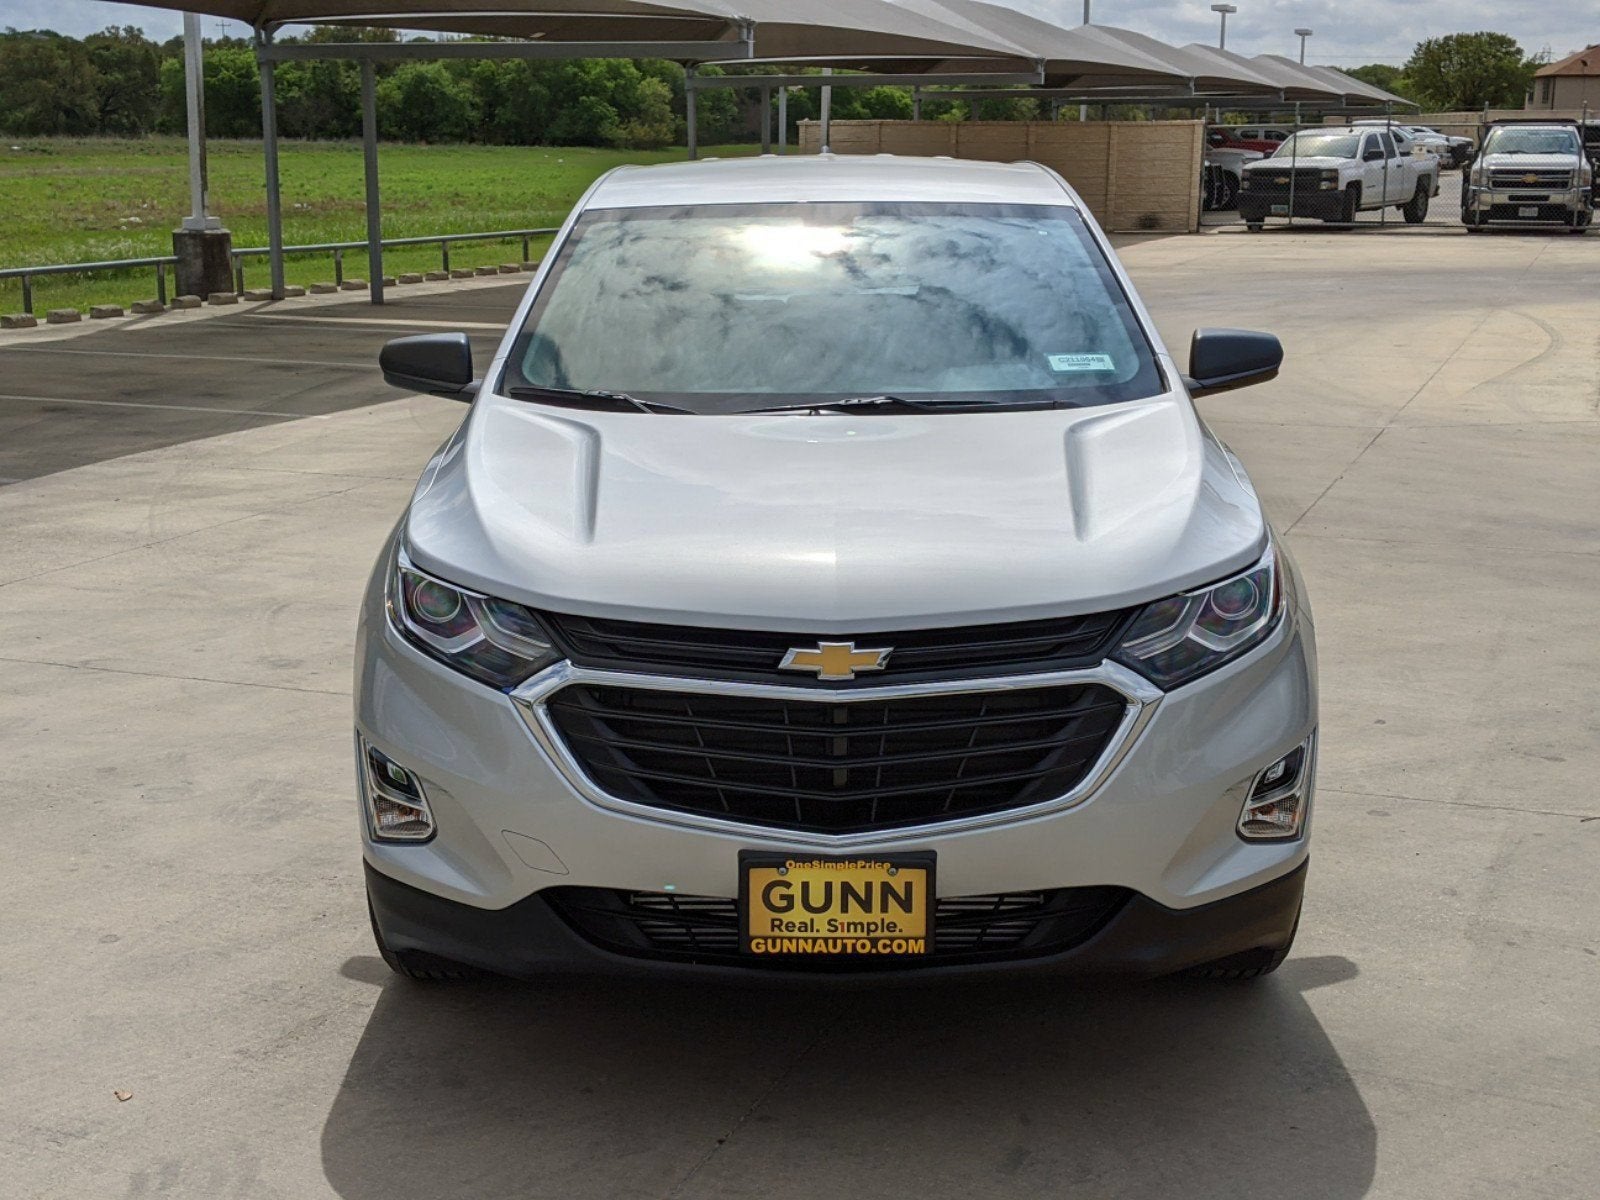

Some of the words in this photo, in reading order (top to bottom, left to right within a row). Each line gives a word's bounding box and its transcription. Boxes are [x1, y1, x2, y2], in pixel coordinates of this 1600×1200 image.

[785, 859, 891, 872] OneSimplePrice
[761, 879, 914, 915] GUNN
[770, 917, 821, 933] Real.
[750, 937, 926, 954] GUNNAUTO.COM
